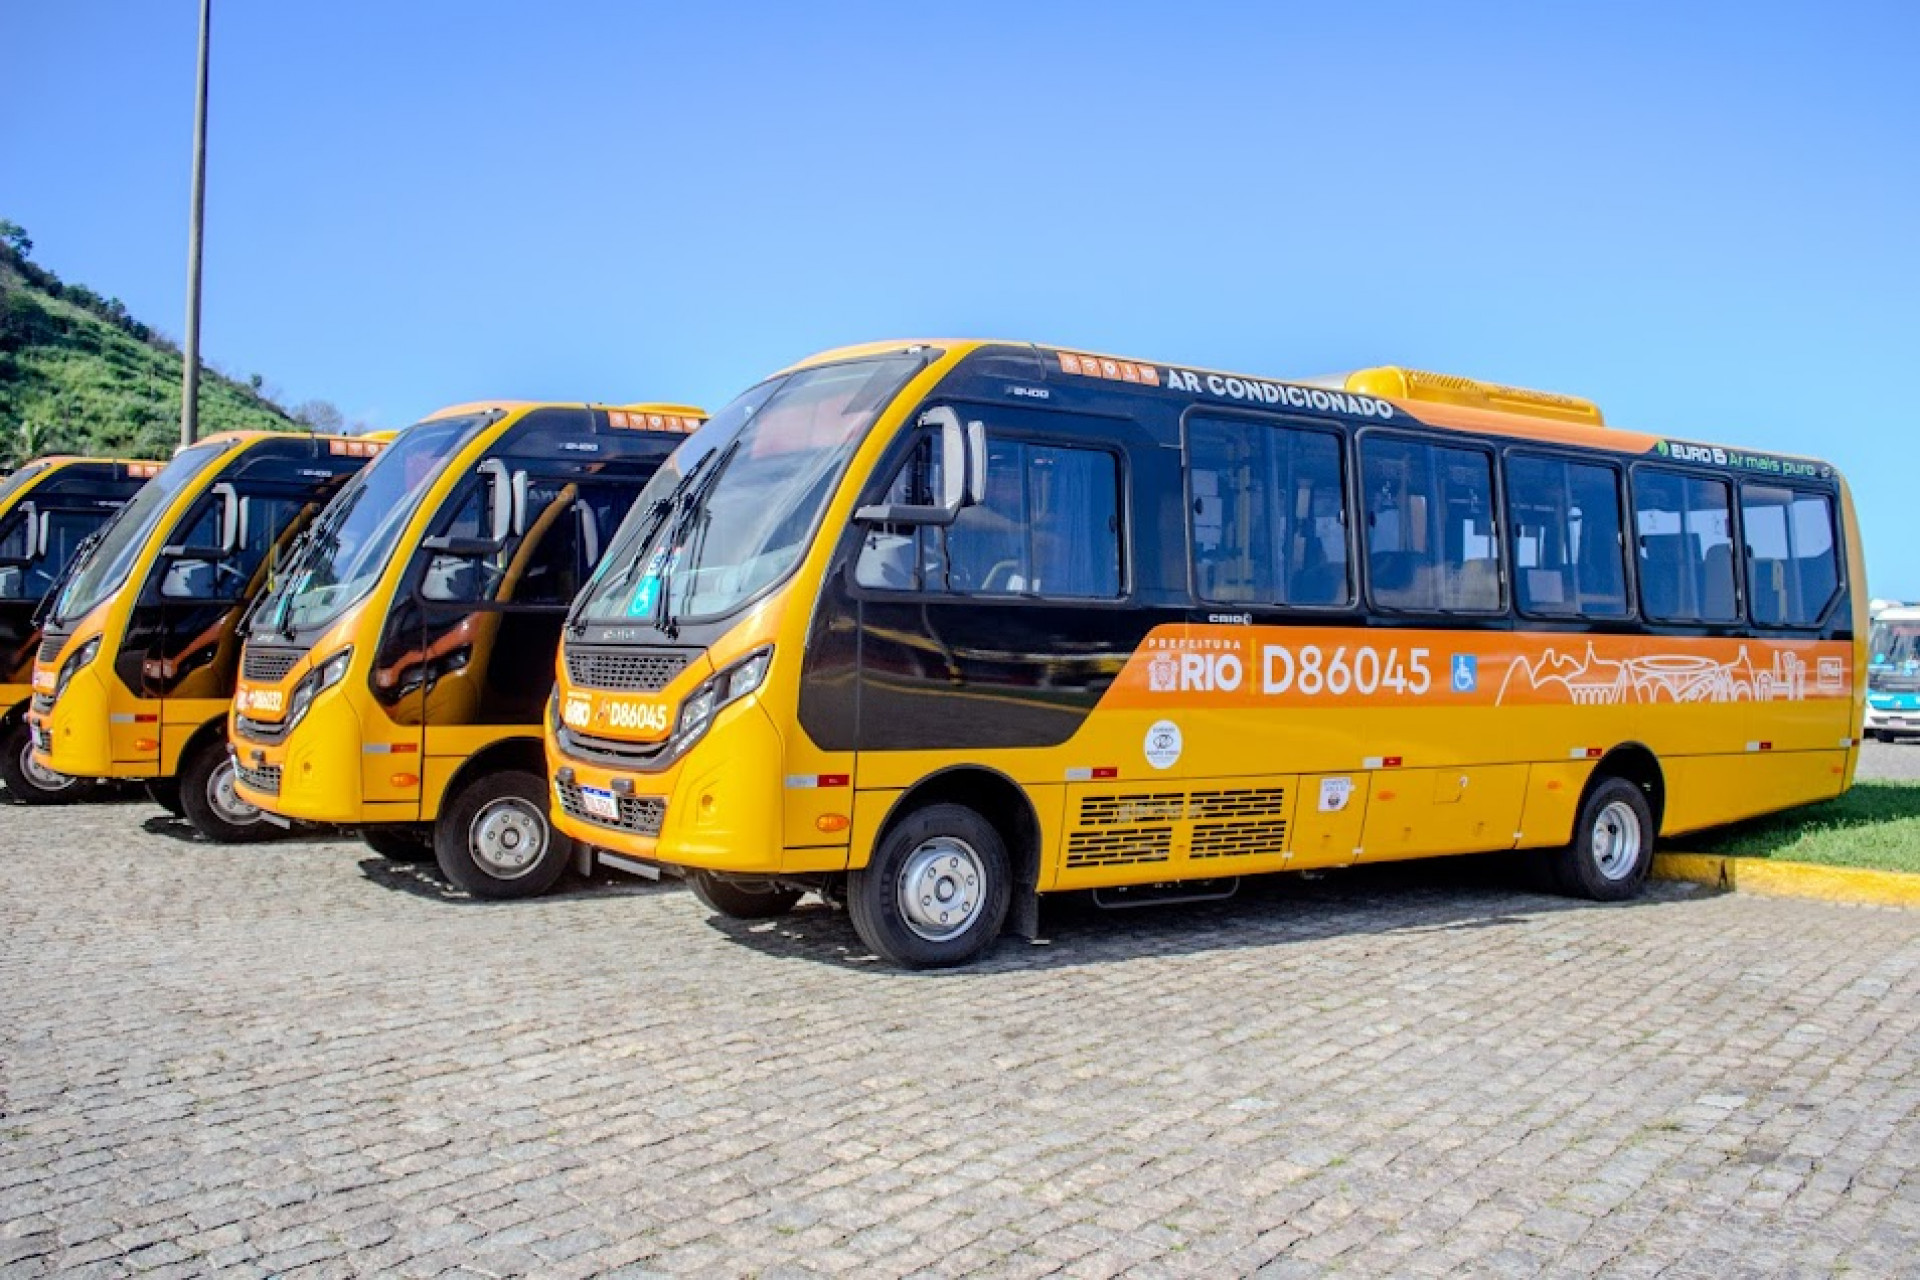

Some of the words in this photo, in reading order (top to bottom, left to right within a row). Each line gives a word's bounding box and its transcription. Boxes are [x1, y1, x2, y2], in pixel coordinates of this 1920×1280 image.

[1167, 369, 1202, 394] AR
[1207, 377, 1393, 419] CONDICIONADO
[1671, 444, 1711, 463] EURO
[1149, 638, 1241, 650] PREFEITURA
[1180, 654, 1243, 692] RIO
[1263, 645, 1431, 695] D86045
[610, 701, 668, 732] D86045
